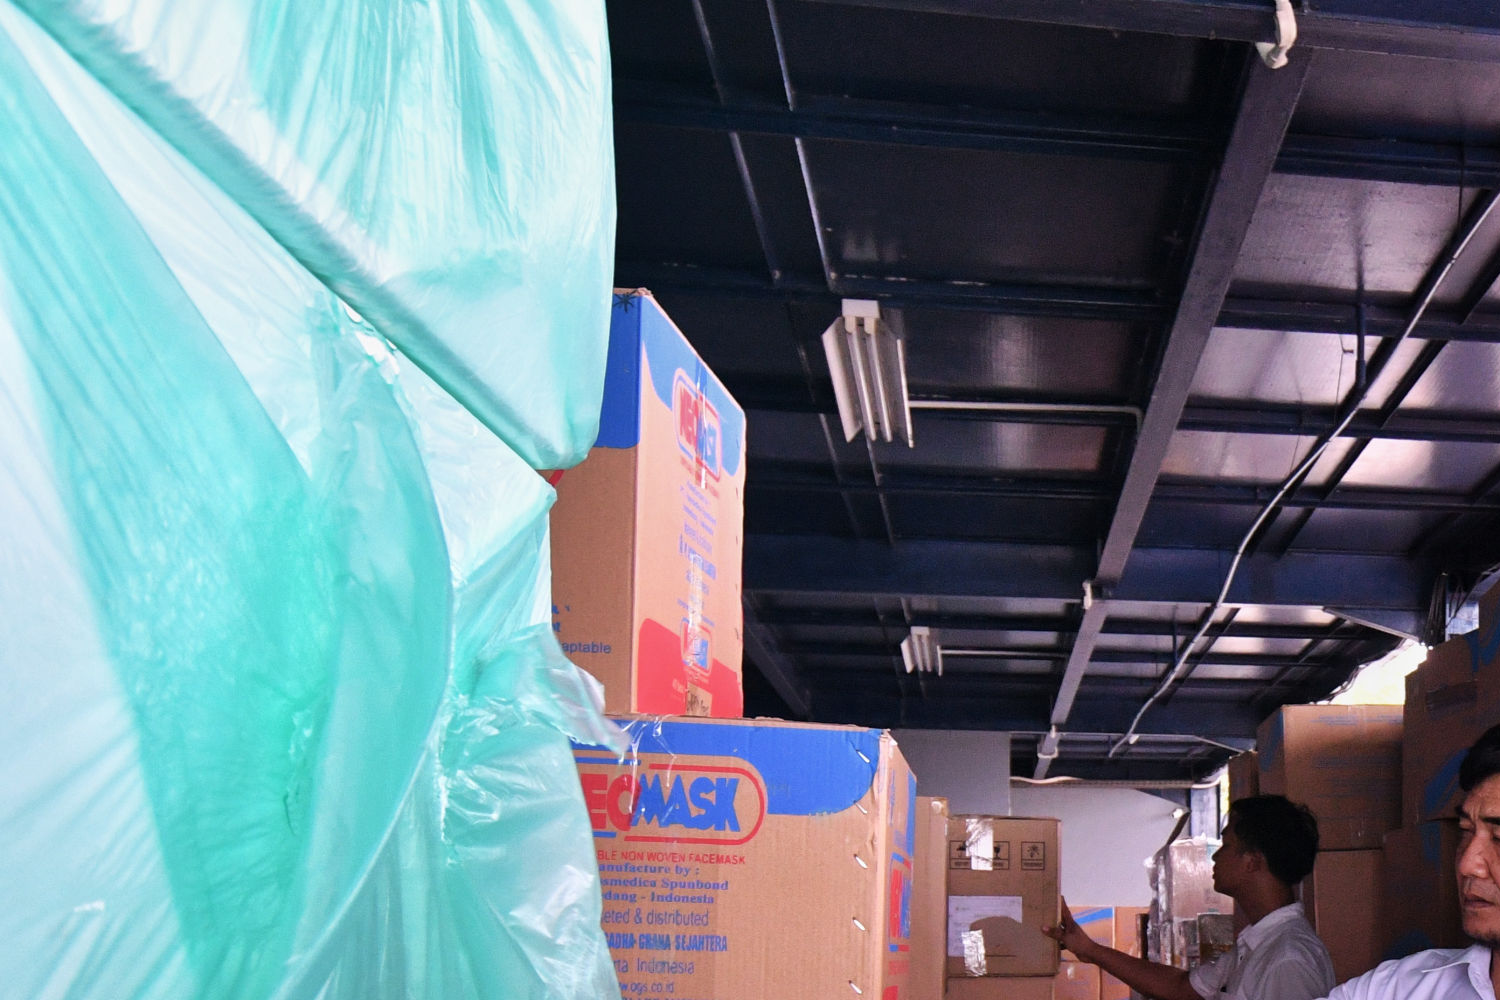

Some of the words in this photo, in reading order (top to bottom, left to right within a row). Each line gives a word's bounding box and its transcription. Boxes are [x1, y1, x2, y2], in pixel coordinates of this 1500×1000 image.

[561, 641, 612, 655] aptable
[580, 772, 741, 833] EOMASK
[597, 850, 617, 862] BLE
[620, 850, 644, 862] NON
[647, 851, 686, 864] WOVEN
[688, 852, 746, 866] FACEMASK
[599, 862, 671, 874] anufacture
[602, 889, 637, 904] dang
[603, 908, 630, 924] eted
[646, 909, 710, 927] distributed
[613, 959, 629, 973] rta
[637, 957, 695, 975] Indonesia
